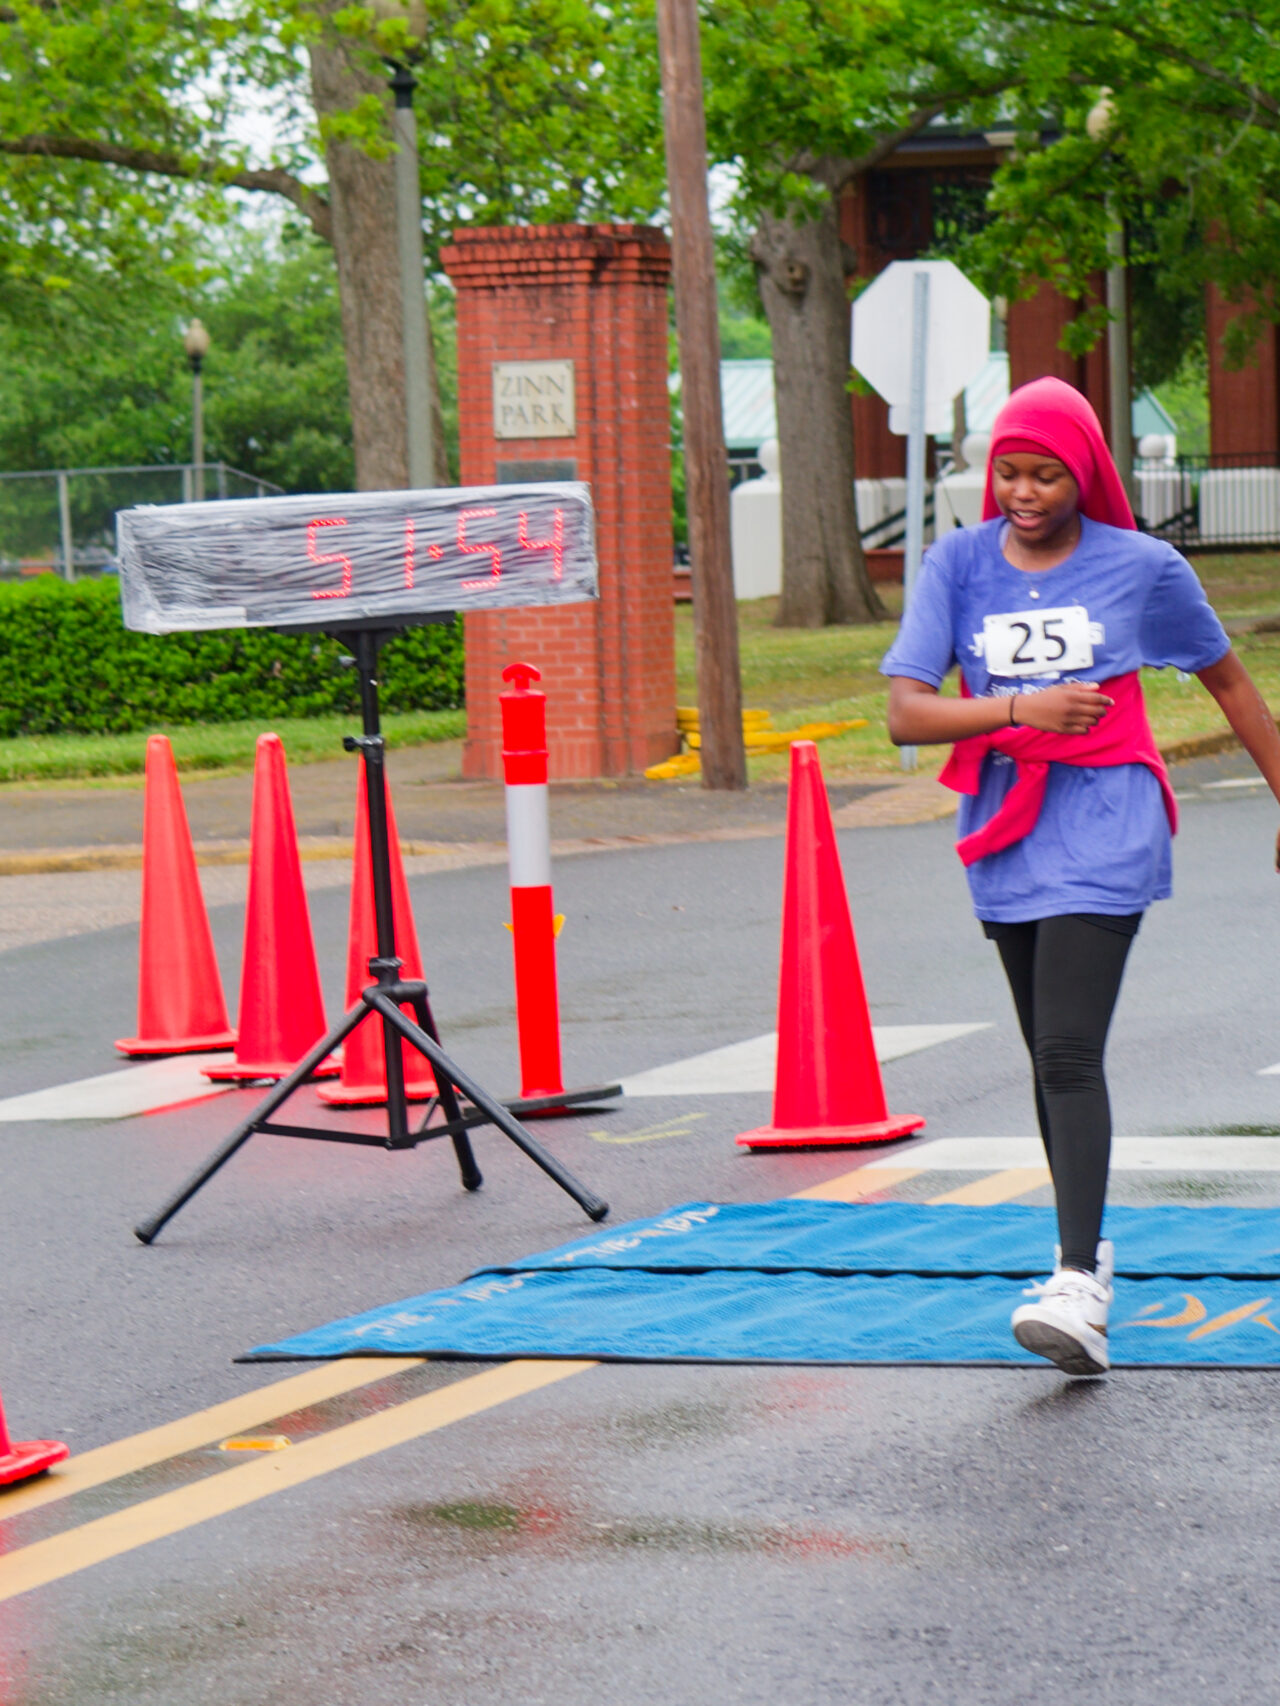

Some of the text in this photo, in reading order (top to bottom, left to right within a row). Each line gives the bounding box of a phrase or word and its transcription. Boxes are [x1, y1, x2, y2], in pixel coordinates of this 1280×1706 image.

[500, 374, 567, 397] ZINN
[501, 403, 566, 425] PARK
[1009, 619, 1066, 664] 25
